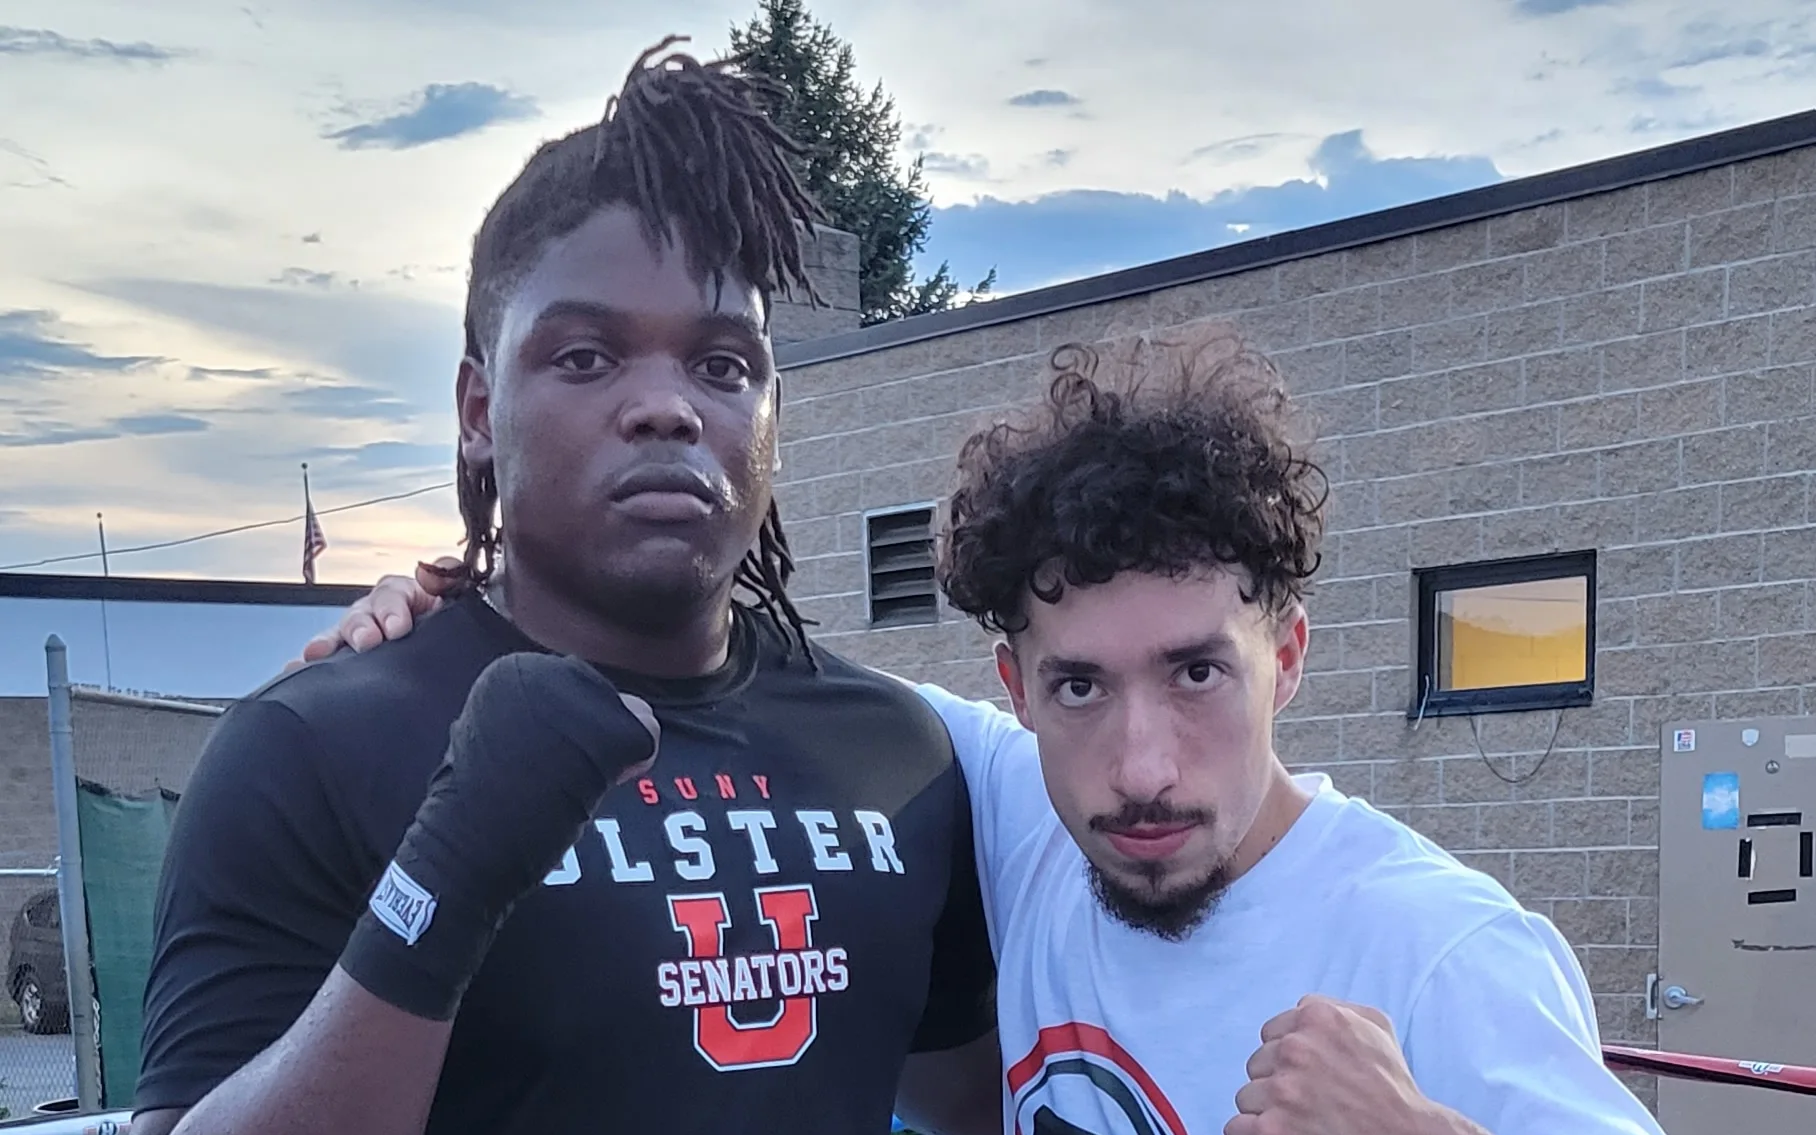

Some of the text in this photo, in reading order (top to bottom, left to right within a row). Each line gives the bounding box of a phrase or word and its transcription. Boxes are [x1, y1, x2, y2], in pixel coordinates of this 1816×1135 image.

[637, 774, 770, 804] SUNY
[658, 948, 849, 1006] SENATORS
[666, 884, 819, 1072] U
